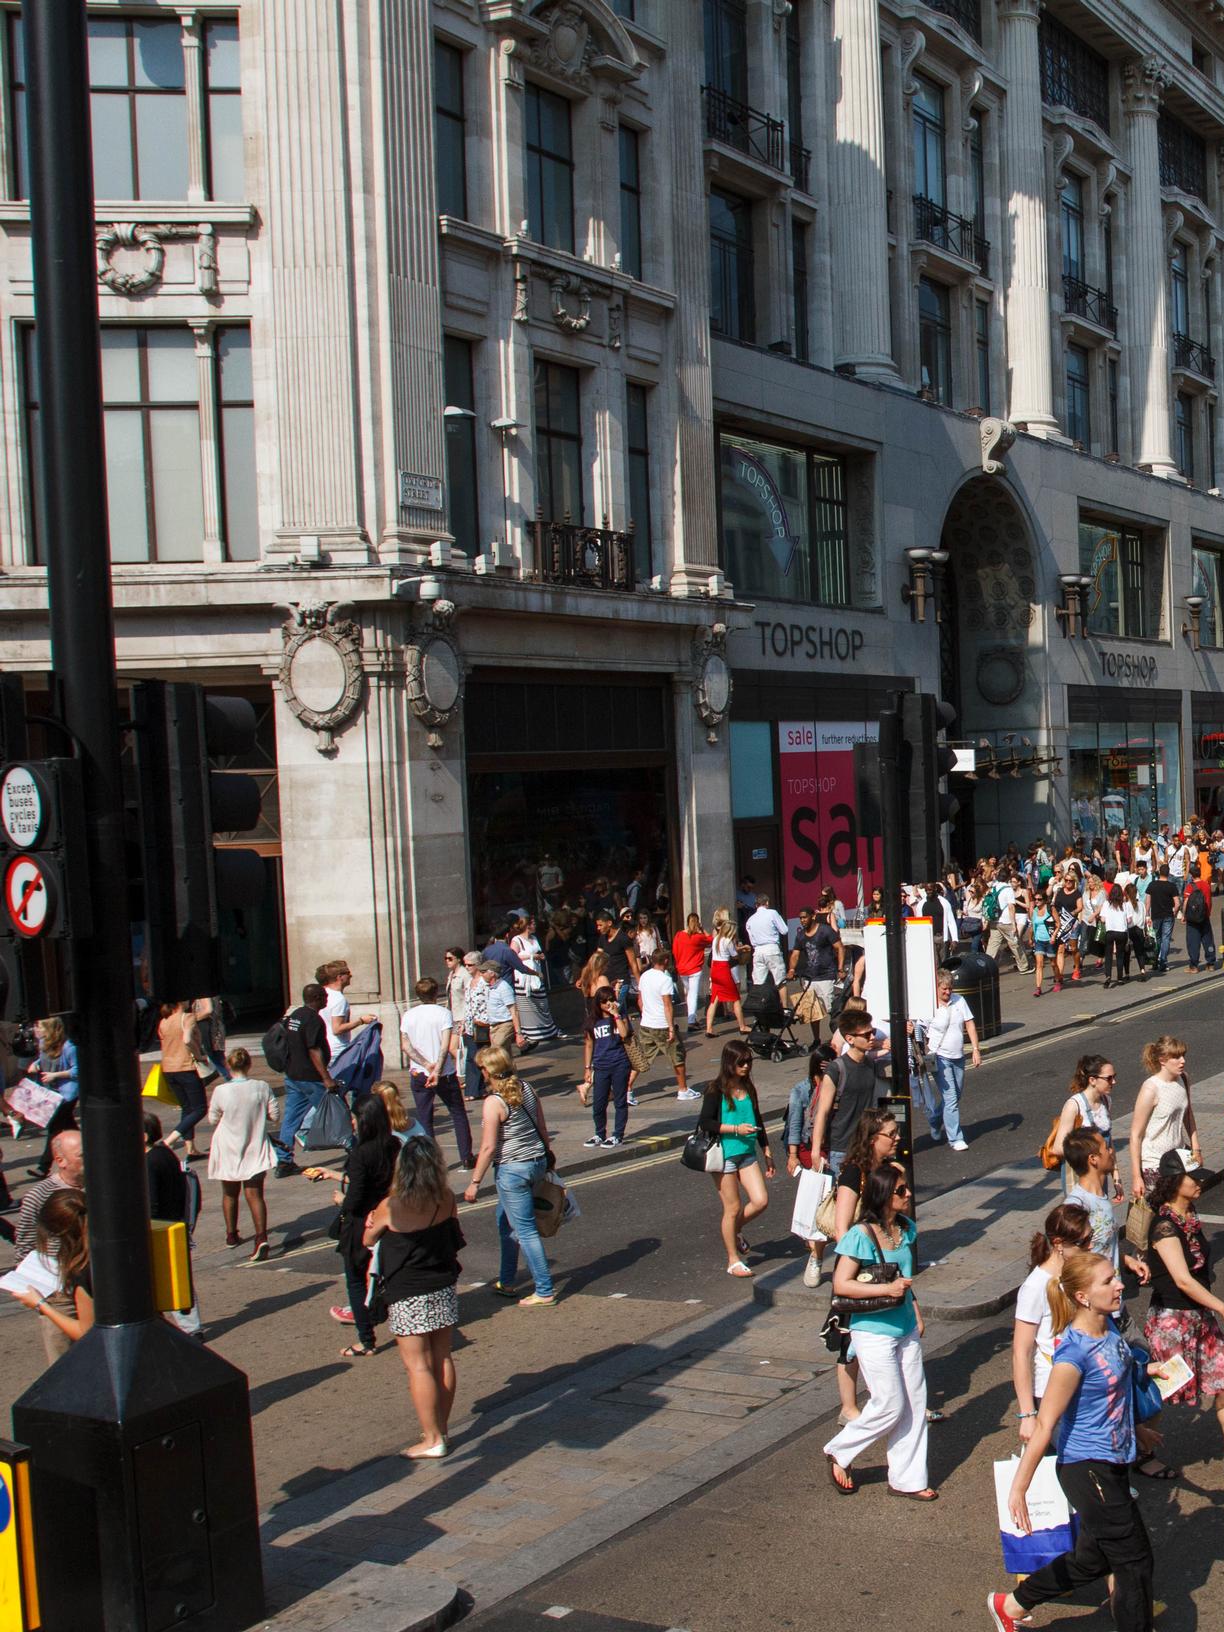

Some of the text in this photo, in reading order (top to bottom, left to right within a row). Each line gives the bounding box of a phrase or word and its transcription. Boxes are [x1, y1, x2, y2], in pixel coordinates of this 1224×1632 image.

[404, 488, 429, 500] STREET
[740, 461, 785, 538] TOPSHOP
[755, 621, 864, 661] TOPSHOP
[1099, 652, 1157, 680] TOPSHOP
[787, 726, 813, 746] sale
[821, 733, 844, 745] further
[7, 783, 36, 795] Except
[788, 777, 837, 795] TOPSHOP
[10, 808, 36, 822] cycles
[18, 823, 40, 833] taxis
